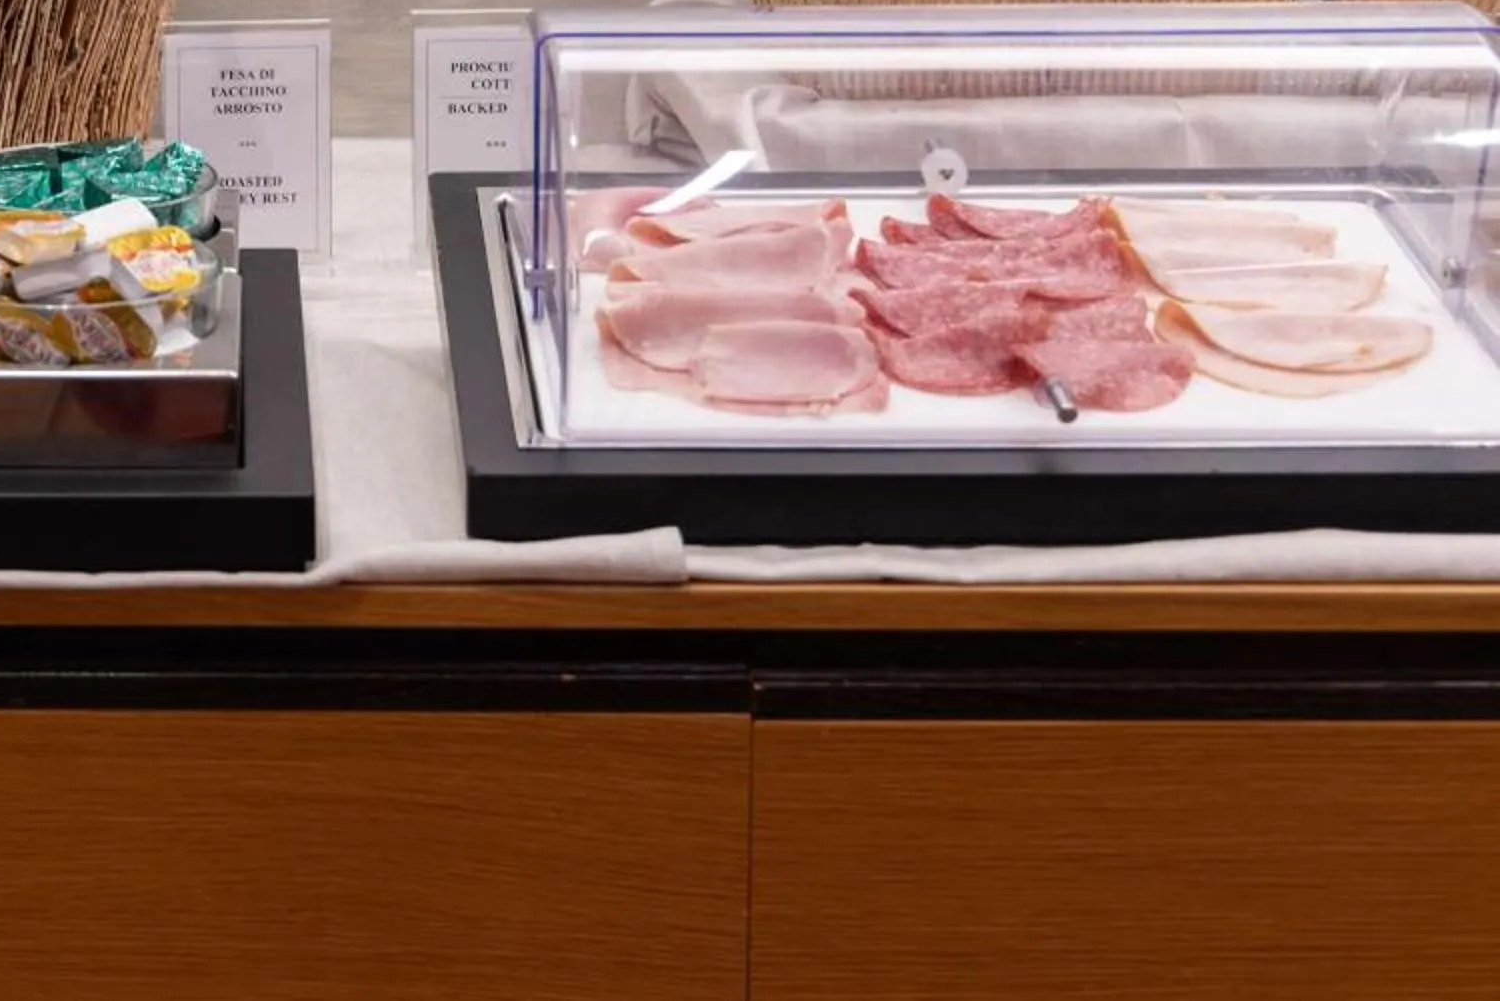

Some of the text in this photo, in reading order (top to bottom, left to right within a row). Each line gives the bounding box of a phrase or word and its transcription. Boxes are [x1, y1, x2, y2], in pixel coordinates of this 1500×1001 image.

[220, 68, 276, 80] FESA DI
[450, 62, 513, 74] PROSCIU
[471, 78, 512, 90] COTT
[210, 85, 288, 98] TACCHINO
[213, 102, 284, 115] ARROSTO
[447, 102, 509, 114] BACKED
